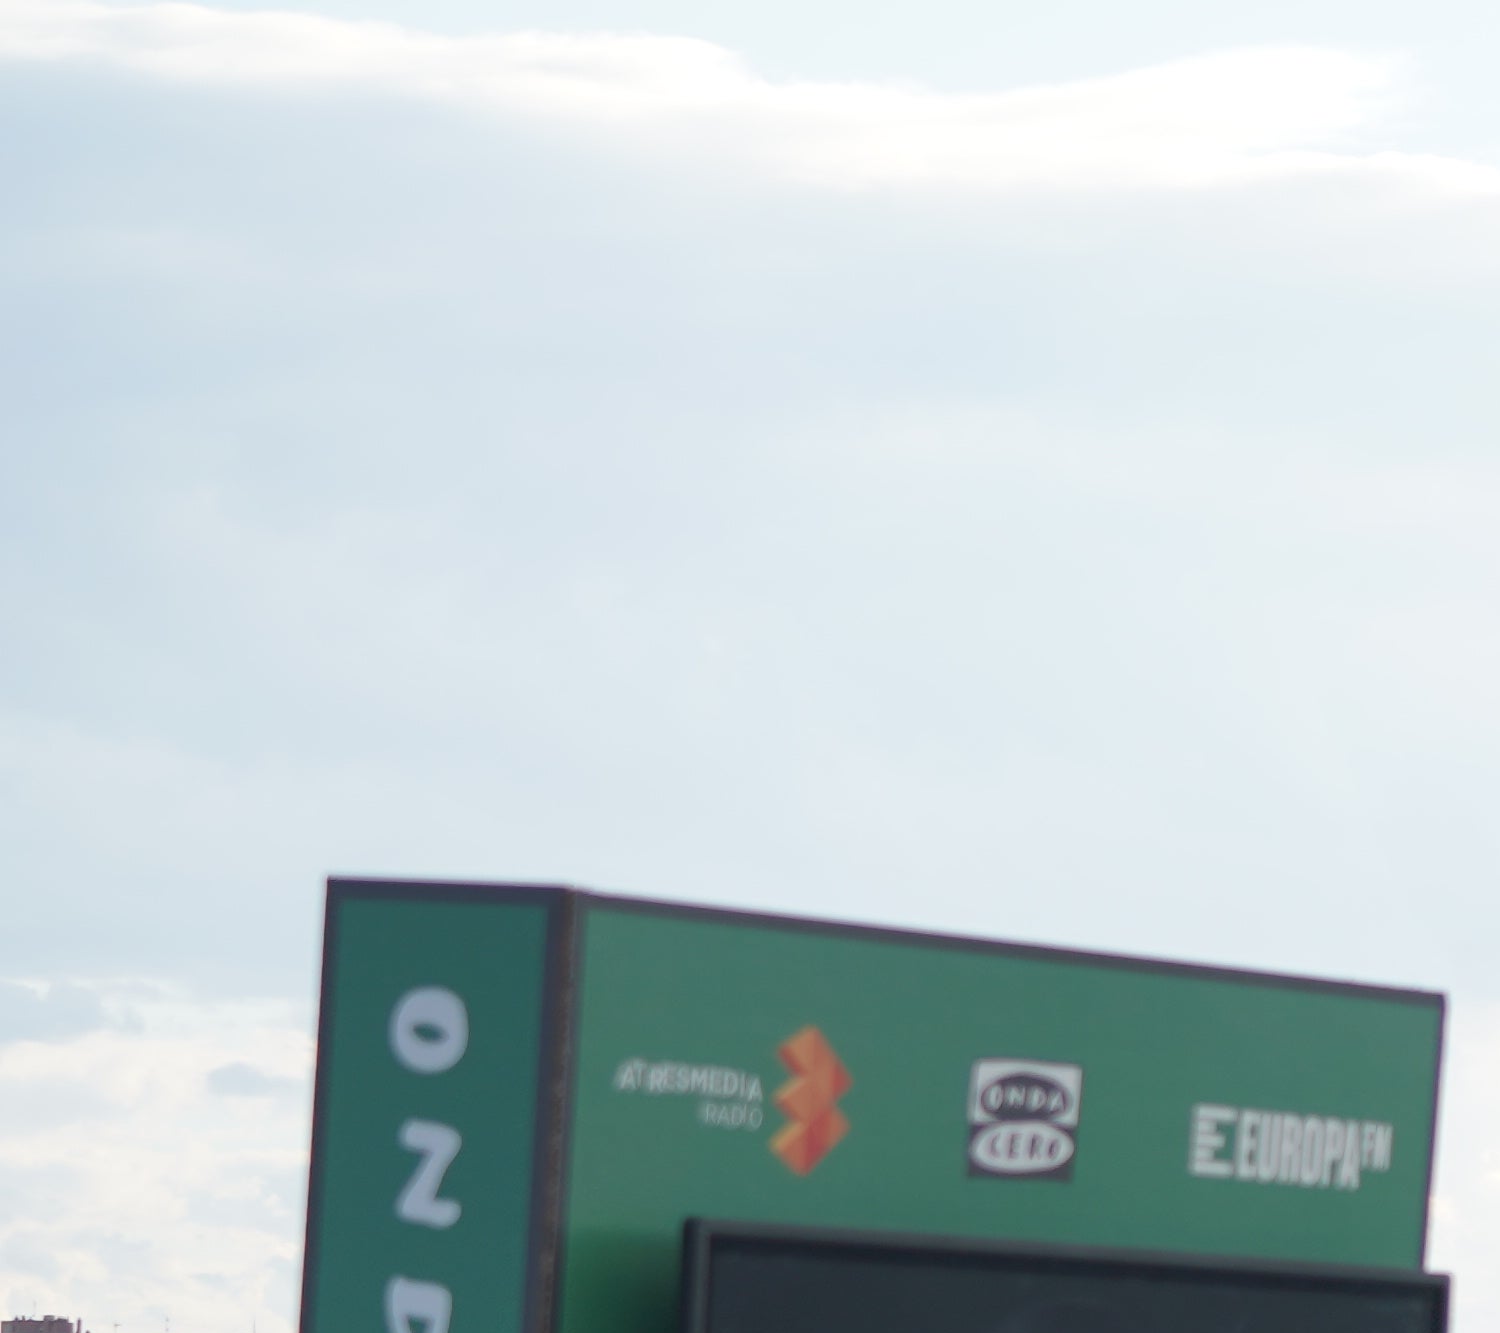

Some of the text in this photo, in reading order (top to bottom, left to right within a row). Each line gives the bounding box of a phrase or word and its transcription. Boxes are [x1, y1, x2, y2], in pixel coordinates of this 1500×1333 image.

[615, 1058, 763, 1103] ATRESMEDIA
[984, 1083, 1068, 1114] ONDA
[702, 1101, 763, 1131] RADIO
[987, 1129, 1062, 1161] CERO
